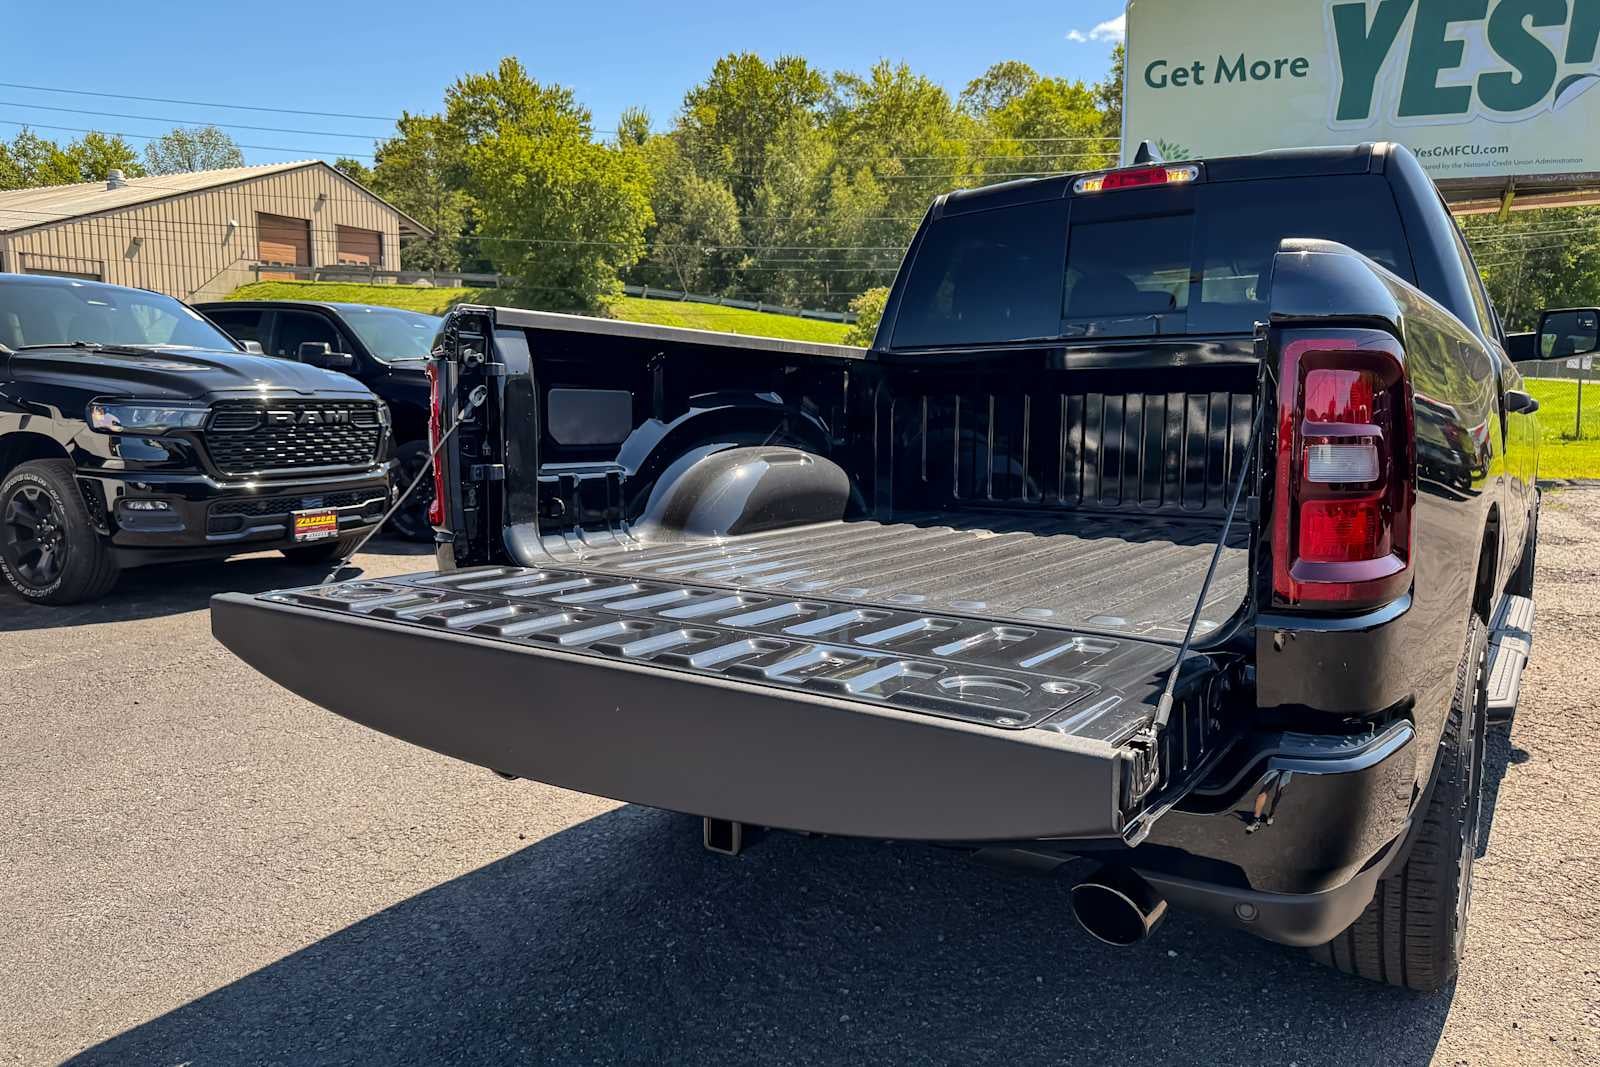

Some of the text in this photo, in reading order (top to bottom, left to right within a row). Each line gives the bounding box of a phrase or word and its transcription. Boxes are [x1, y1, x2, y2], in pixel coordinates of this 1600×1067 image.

[1144, 53, 1309, 89] Get More
[1413, 144, 1509, 158] YesGMFCU.com
[1441, 161, 1450, 171] by
[1452, 161, 1462, 169] the
[1463, 160, 1490, 169] National
[1491, 159, 1512, 168] Credit
[1513, 158, 1533, 167] Union
[1534, 157, 1583, 166] Administration
[267, 410, 349, 425] RAM
